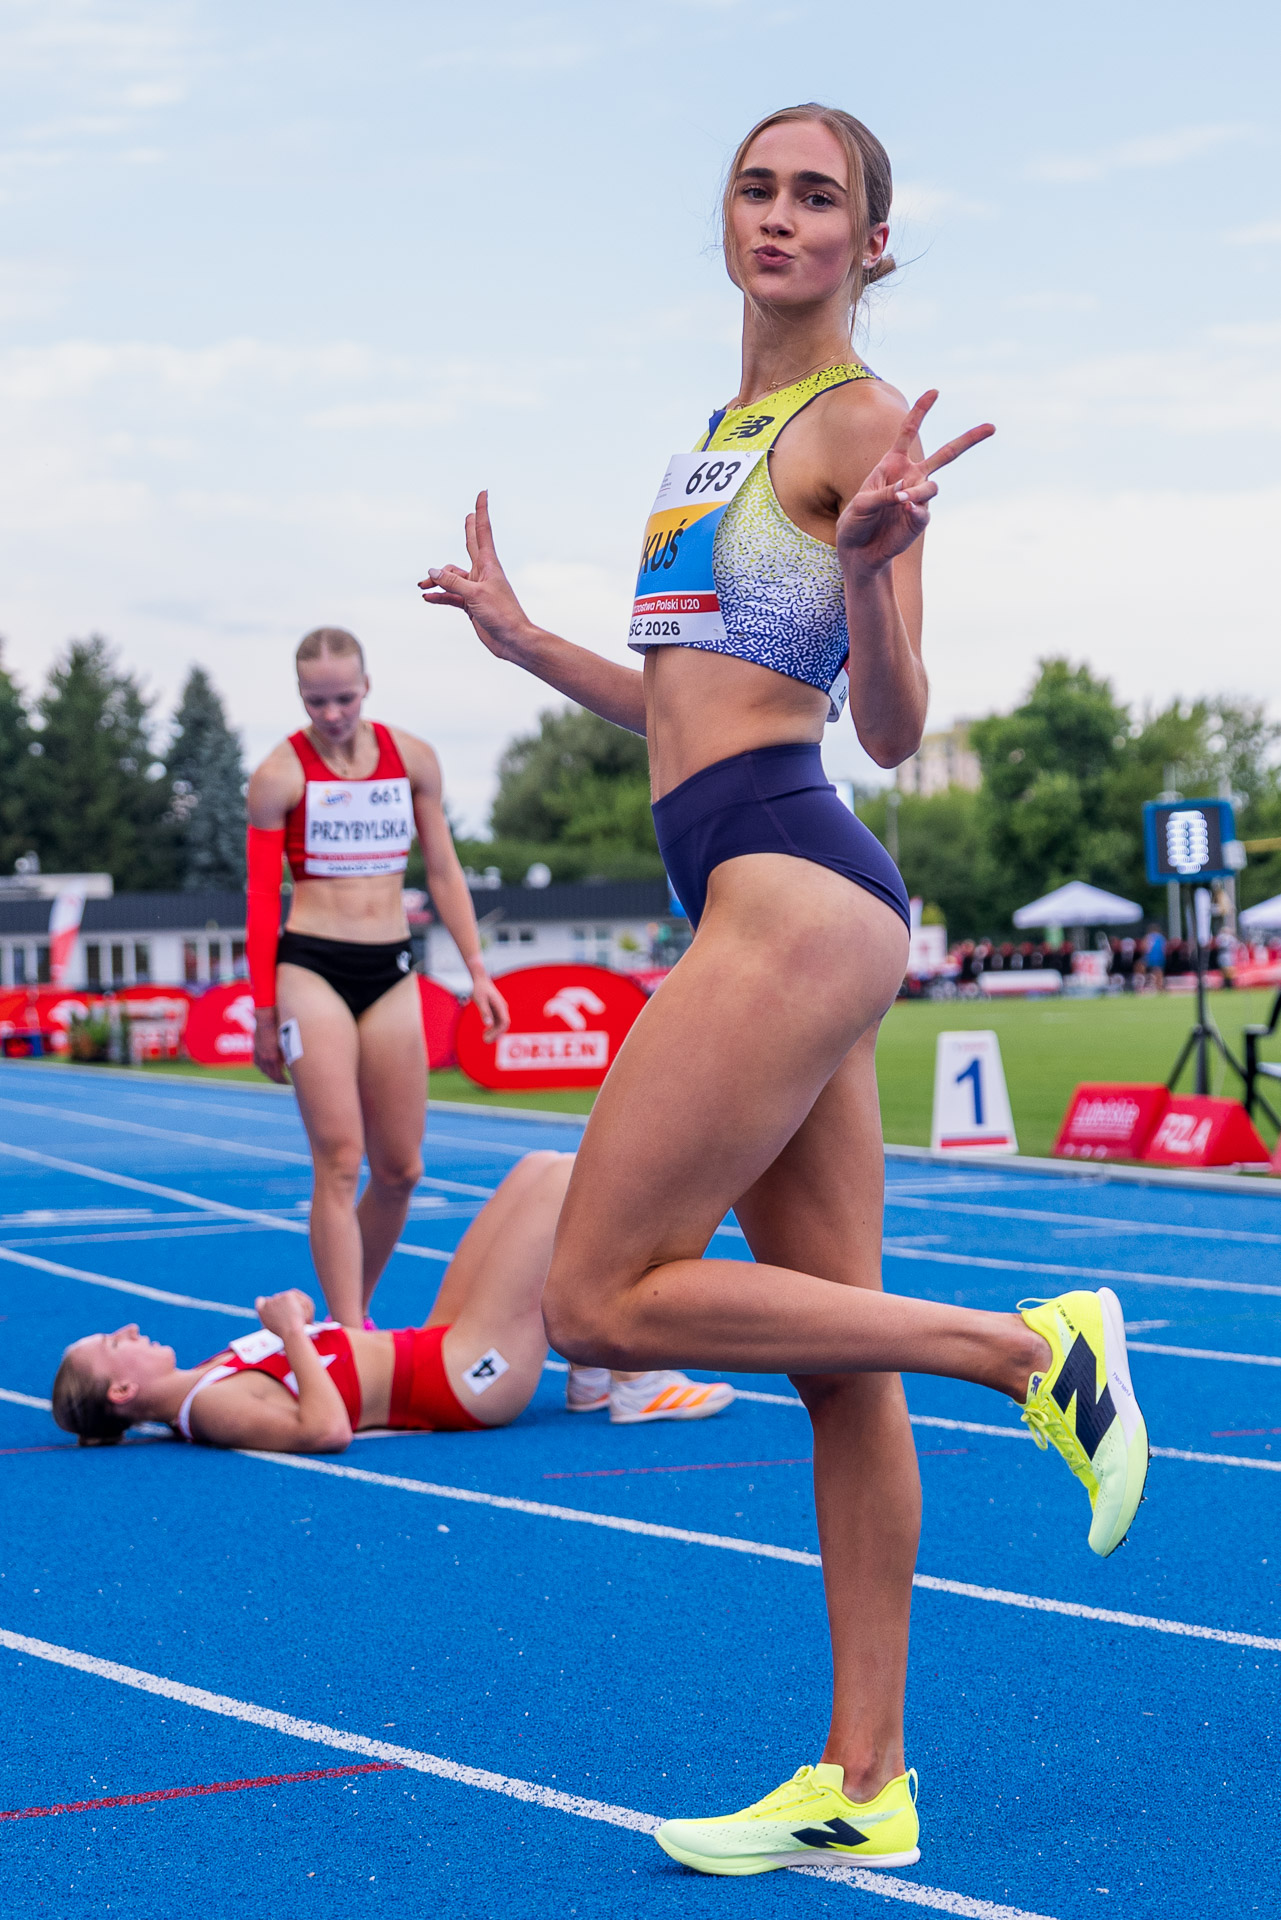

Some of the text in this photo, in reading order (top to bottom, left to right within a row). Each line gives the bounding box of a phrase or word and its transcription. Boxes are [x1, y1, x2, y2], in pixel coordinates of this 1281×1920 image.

[686, 461, 741, 495] 693
[639, 518, 688, 574] KUŚ
[655, 598, 678, 611] Polski
[680, 598, 700, 610] U20
[645, 621, 680, 636] 2026
[370, 786, 402, 805] 661
[310, 819, 409, 840] PRZYBYLSKA
[508, 1043, 597, 1059] ORLEN
[955, 1057, 984, 1126] 1
[472, 1357, 495, 1378] 4
